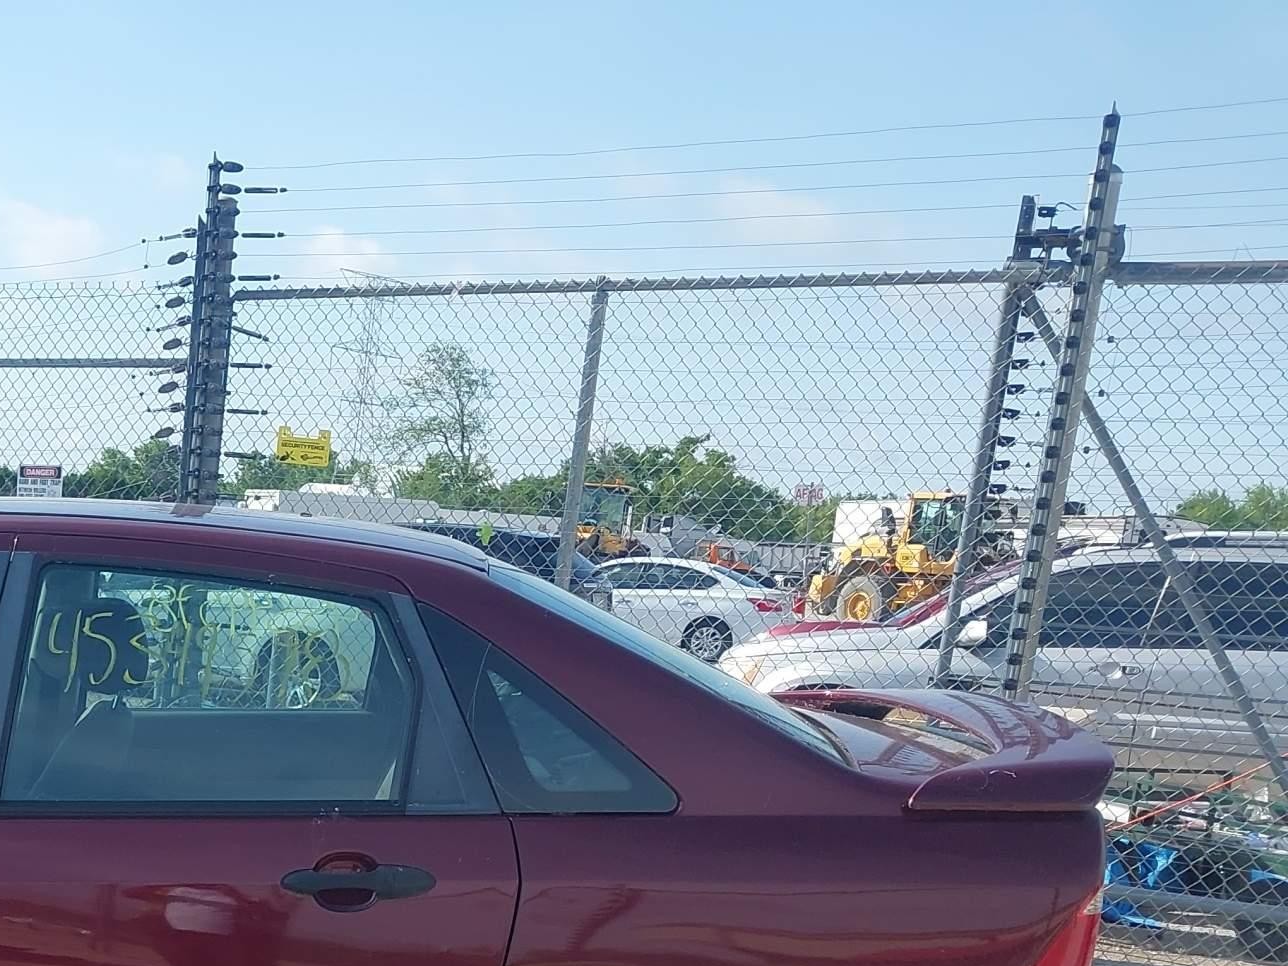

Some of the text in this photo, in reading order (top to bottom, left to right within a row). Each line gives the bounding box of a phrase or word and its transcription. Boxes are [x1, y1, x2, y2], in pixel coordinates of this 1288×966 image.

[281, 442, 325, 451] SECURITY FENCE
[25, 468, 55, 476] DANGER
